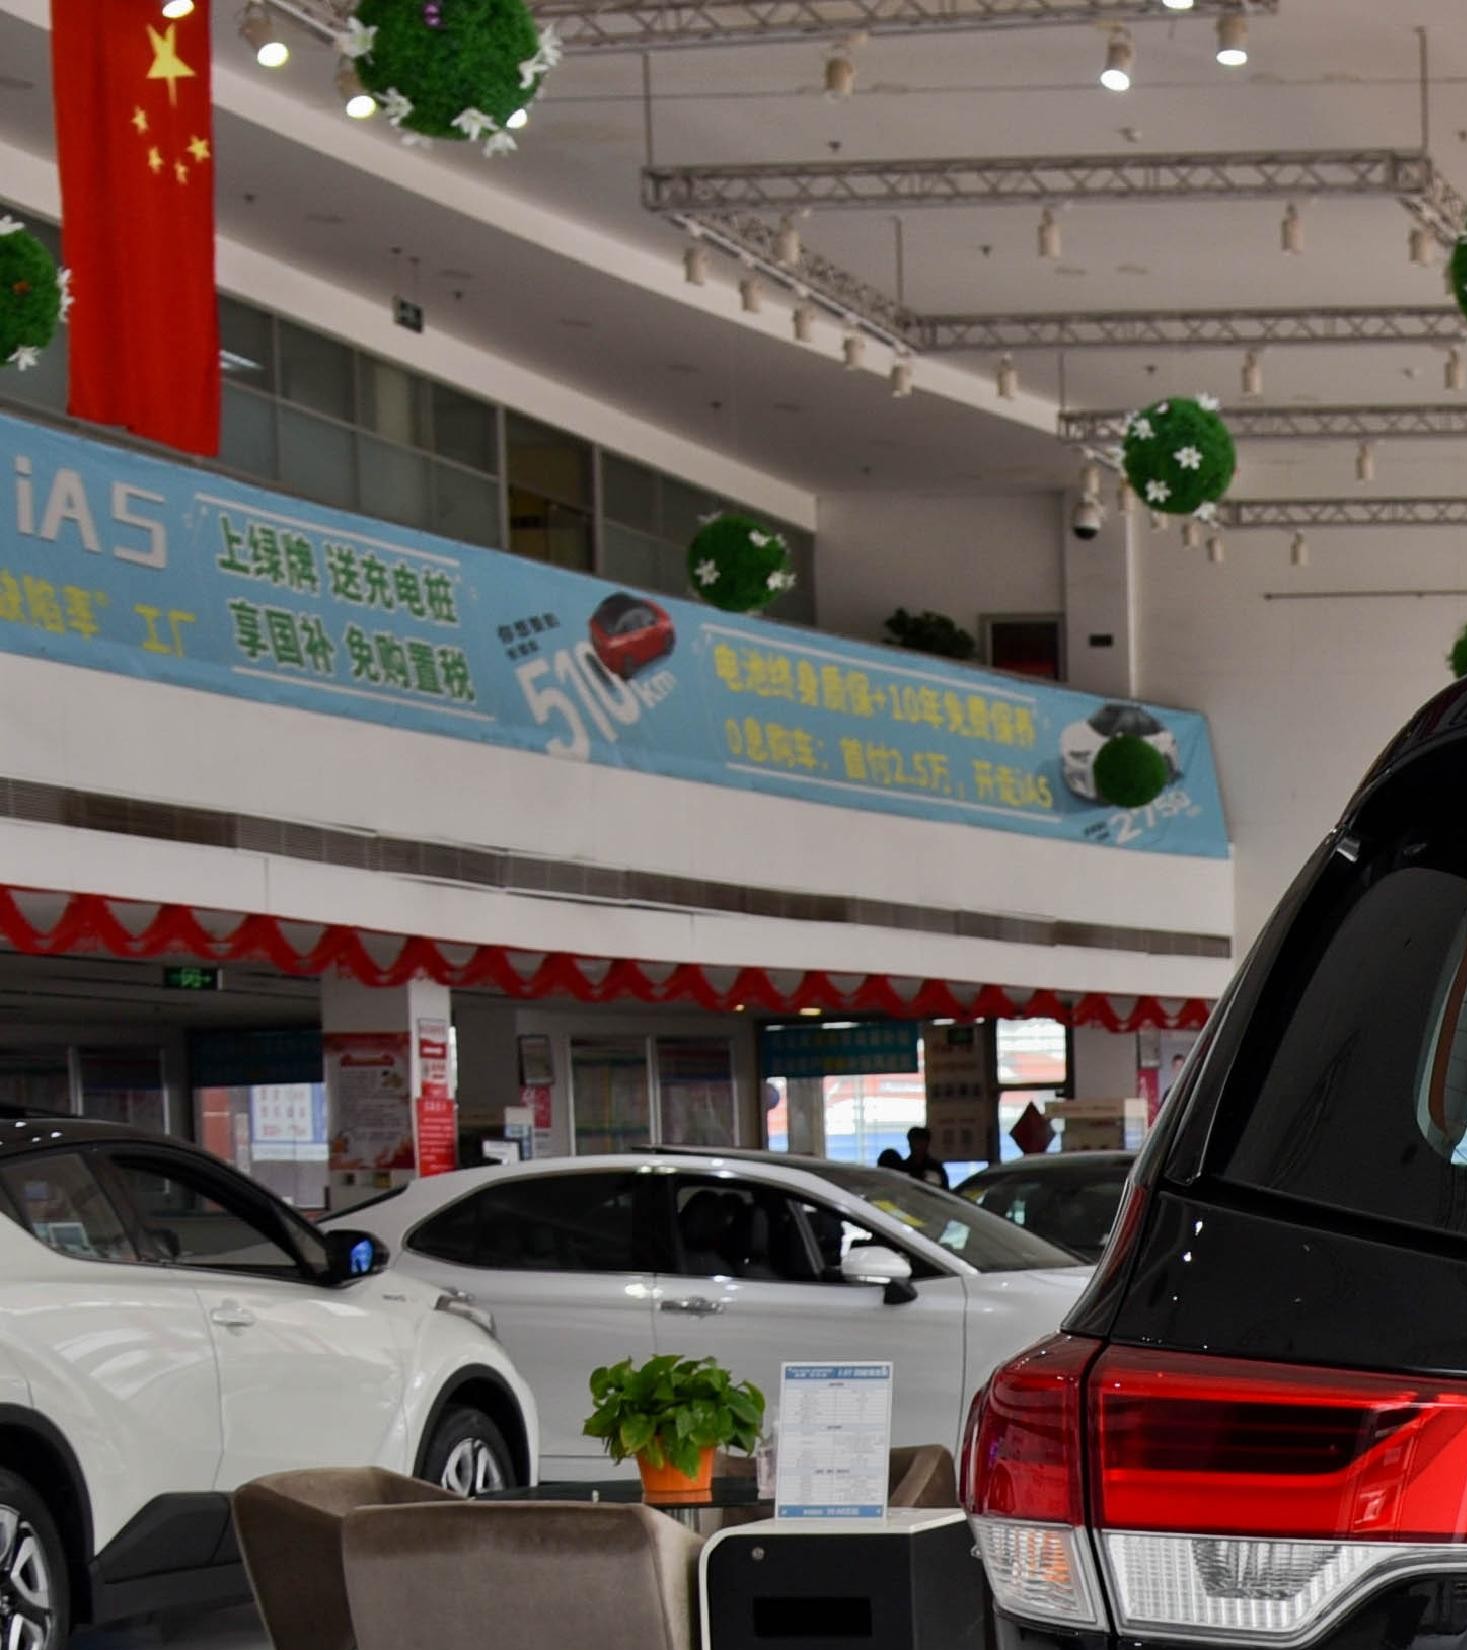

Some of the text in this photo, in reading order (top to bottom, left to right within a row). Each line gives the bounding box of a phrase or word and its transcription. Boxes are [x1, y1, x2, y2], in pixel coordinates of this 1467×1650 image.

[216, 512, 460, 627] 上绿牌 送充电桩
[228, 599, 476, 703] 享国补 免购置税
